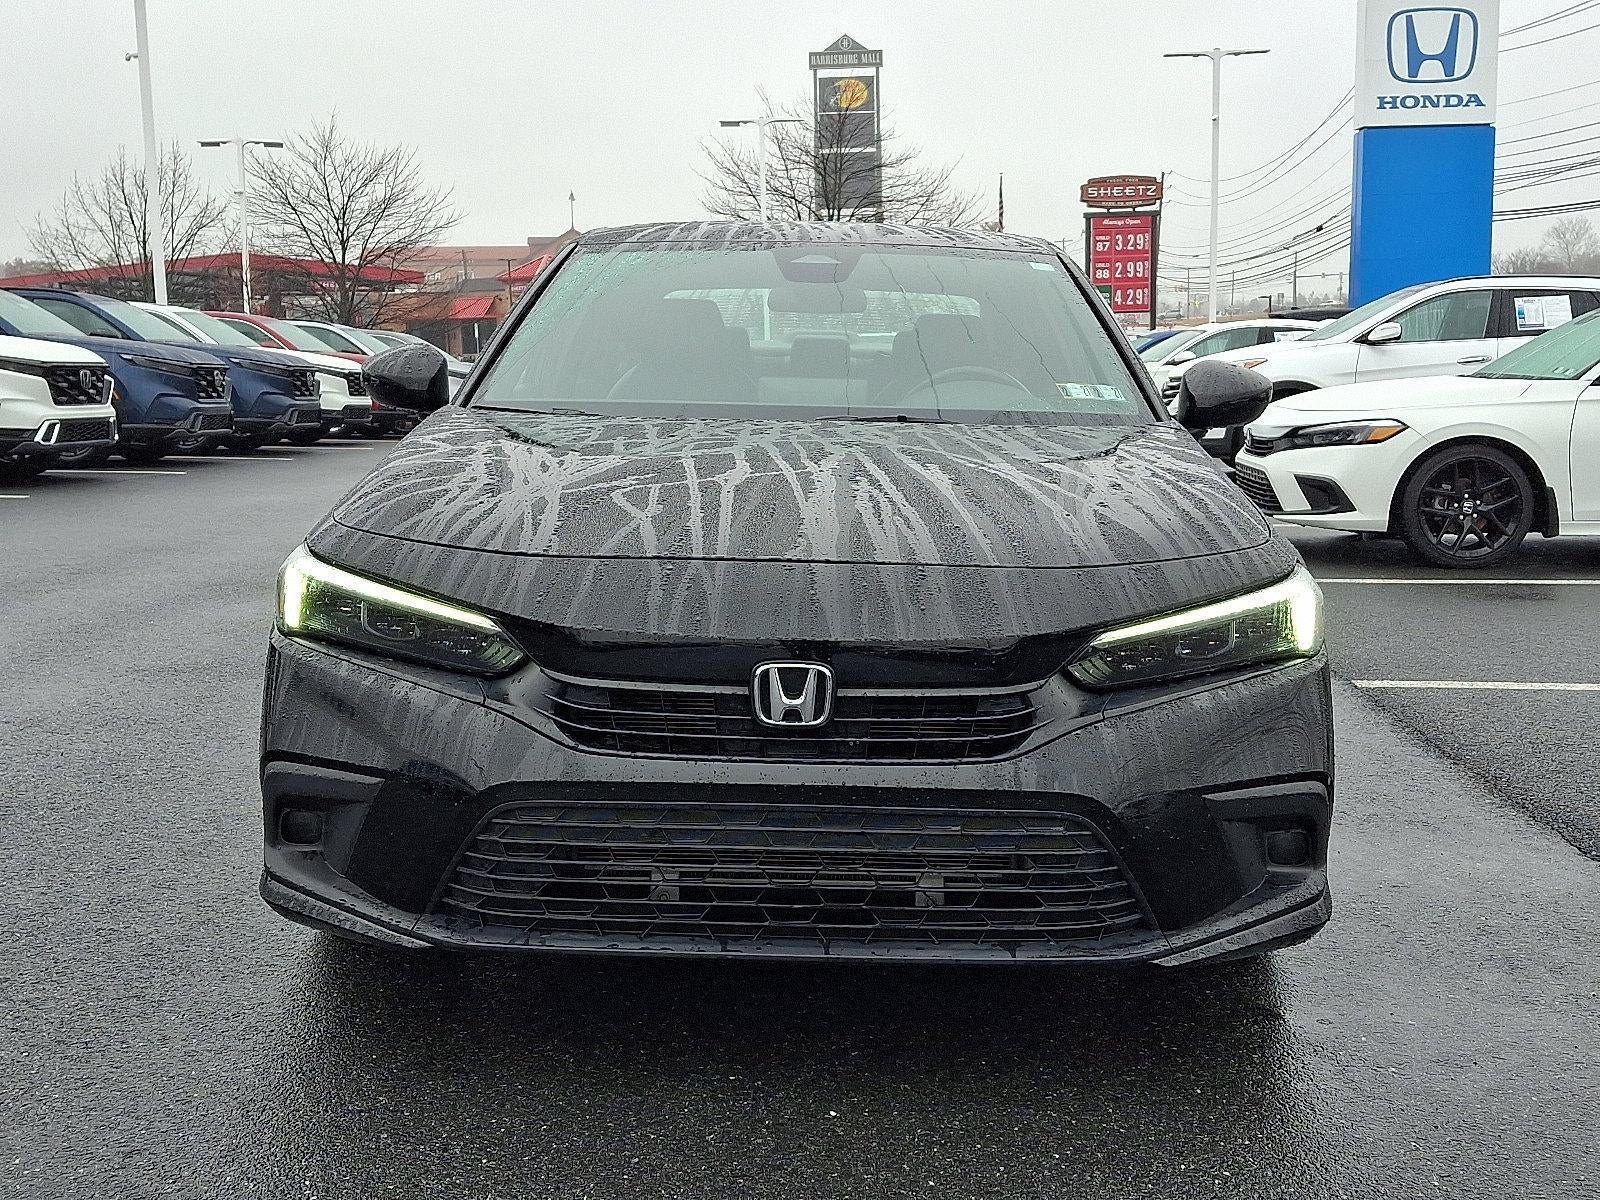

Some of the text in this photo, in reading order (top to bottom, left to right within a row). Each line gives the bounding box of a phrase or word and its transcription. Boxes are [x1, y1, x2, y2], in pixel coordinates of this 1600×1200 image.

[810, 52, 881, 65] HARRISBURG MALL
[1376, 93, 1486, 110] HONDA
[1087, 185, 1157, 198] SHEETZ
[1125, 218, 1142, 226] Open
[1096, 242, 1110, 251] 87
[1095, 269, 1110, 279] 88
